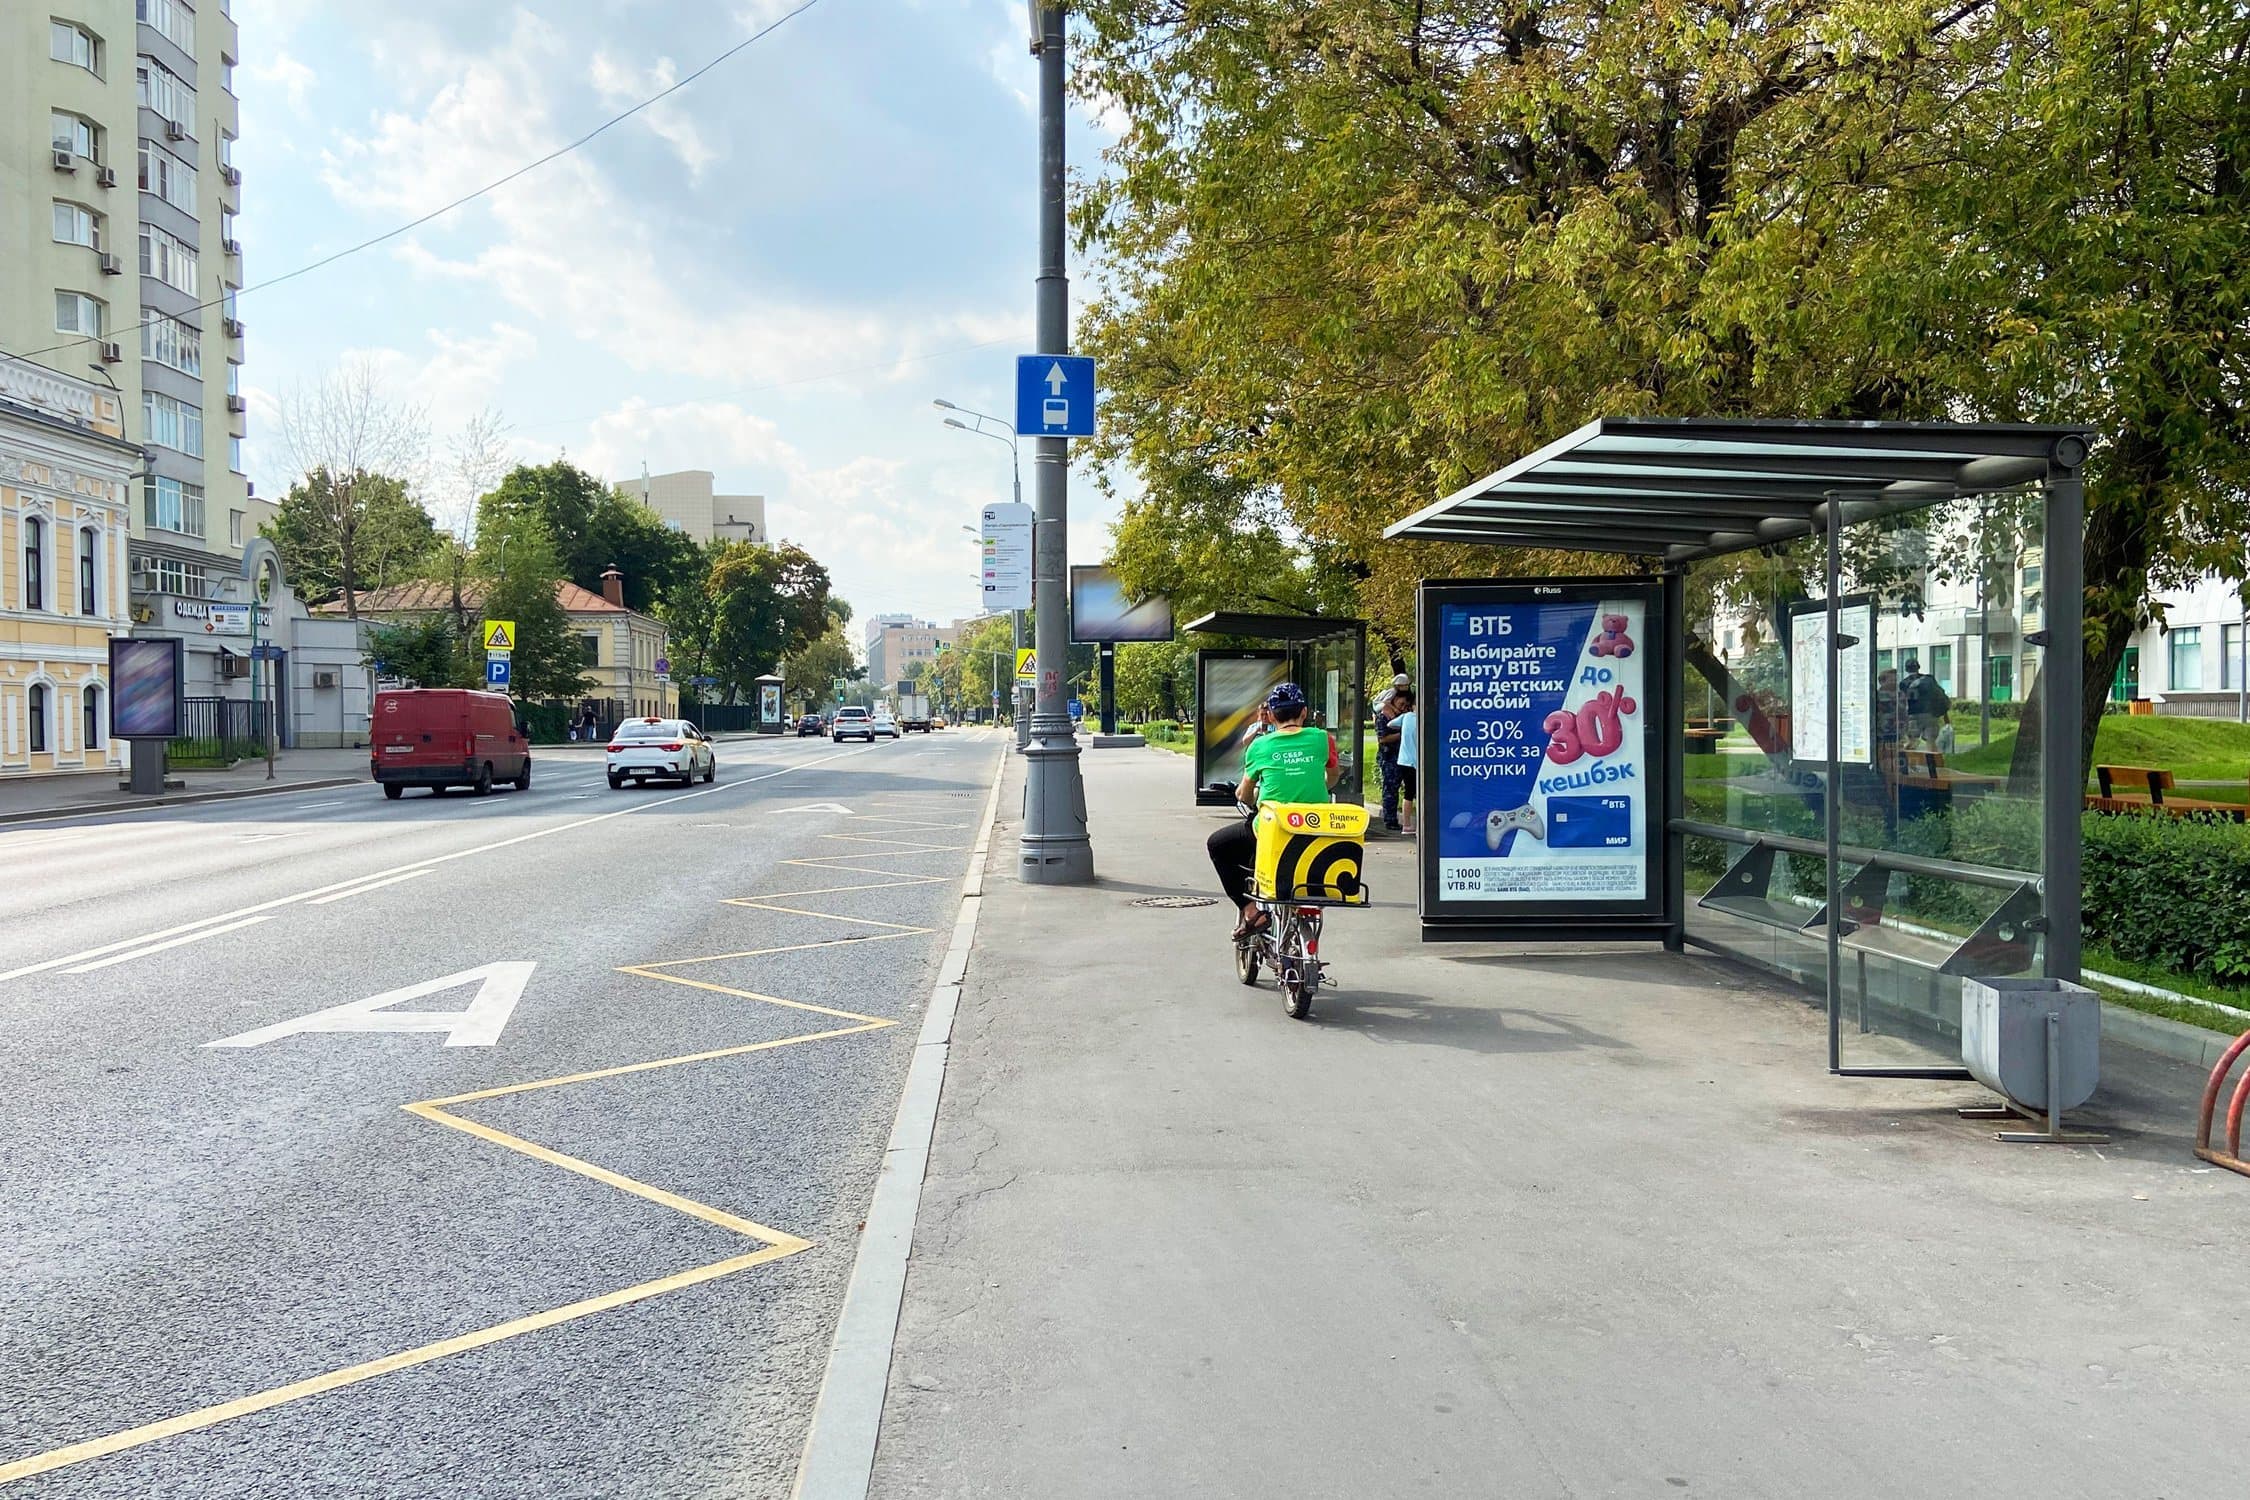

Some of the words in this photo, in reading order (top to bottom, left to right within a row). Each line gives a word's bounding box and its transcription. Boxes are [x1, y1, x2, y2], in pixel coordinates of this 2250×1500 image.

[177, 602, 208, 620] ОДЕЖДА
[1469, 616, 1512, 635] ВТБ
[1449, 644, 1556, 662] Выбирайте
[492, 663, 506, 681] P
[1449, 664, 1502, 679] карту
[1507, 661, 1541, 675] ВТБ
[1579, 665, 1612, 686] до
[1449, 683, 1486, 696] для
[1488, 680, 1564, 695] детских
[1449, 694, 1530, 710] пособий
[1449, 728, 1472, 743] до
[1476, 720, 1523, 740] 30%
[1543, 684, 1636, 765] 30%
[1282, 751, 1304, 759] СБЕР
[1450, 741, 1516, 758] кешбэк
[1520, 745, 1540, 757] за
[1283, 755, 1315, 764] МАРКЕТ
[1450, 762, 1526, 779] покупки
[1539, 760, 1635, 795] кешбэк
[1609, 801, 1626, 809] ВТБ
[1291, 814, 1300, 826] Я
[1329, 813, 1360, 822] Яндекс
[1330, 821, 1346, 829] Еда
[1606, 837, 1627, 845] МИР
[1456, 868, 1481, 878] 1000
[1448, 881, 1481, 891] VTB.RU
